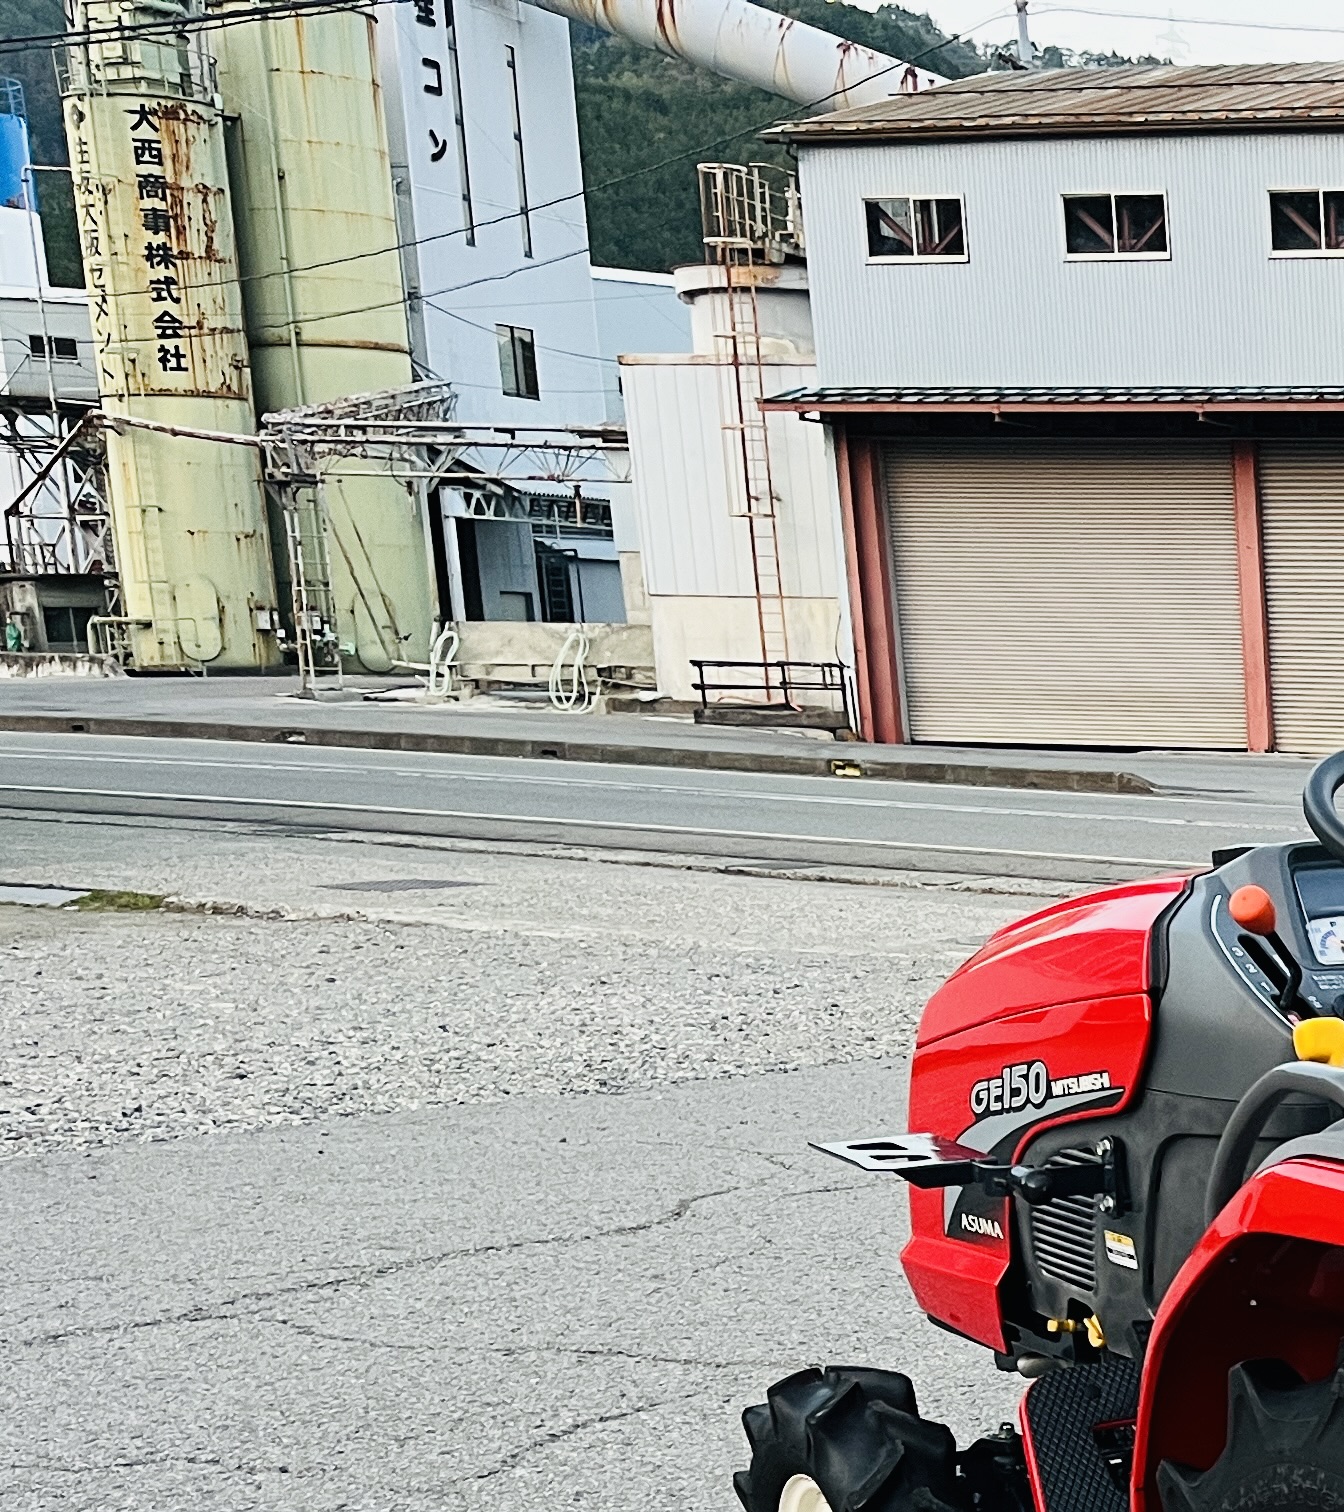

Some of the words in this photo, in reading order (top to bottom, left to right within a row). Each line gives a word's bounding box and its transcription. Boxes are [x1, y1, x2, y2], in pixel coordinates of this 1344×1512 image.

[122, 103, 189, 372] 大西商事株式会社
[1231, 946, 1244, 957] 3
[1245, 963, 1258, 974] 2
[970, 1061, 1047, 1114] GE150
[1050, 1072, 1111, 1097] MITSUBISHI
[961, 1213, 1004, 1240] ASUMA
